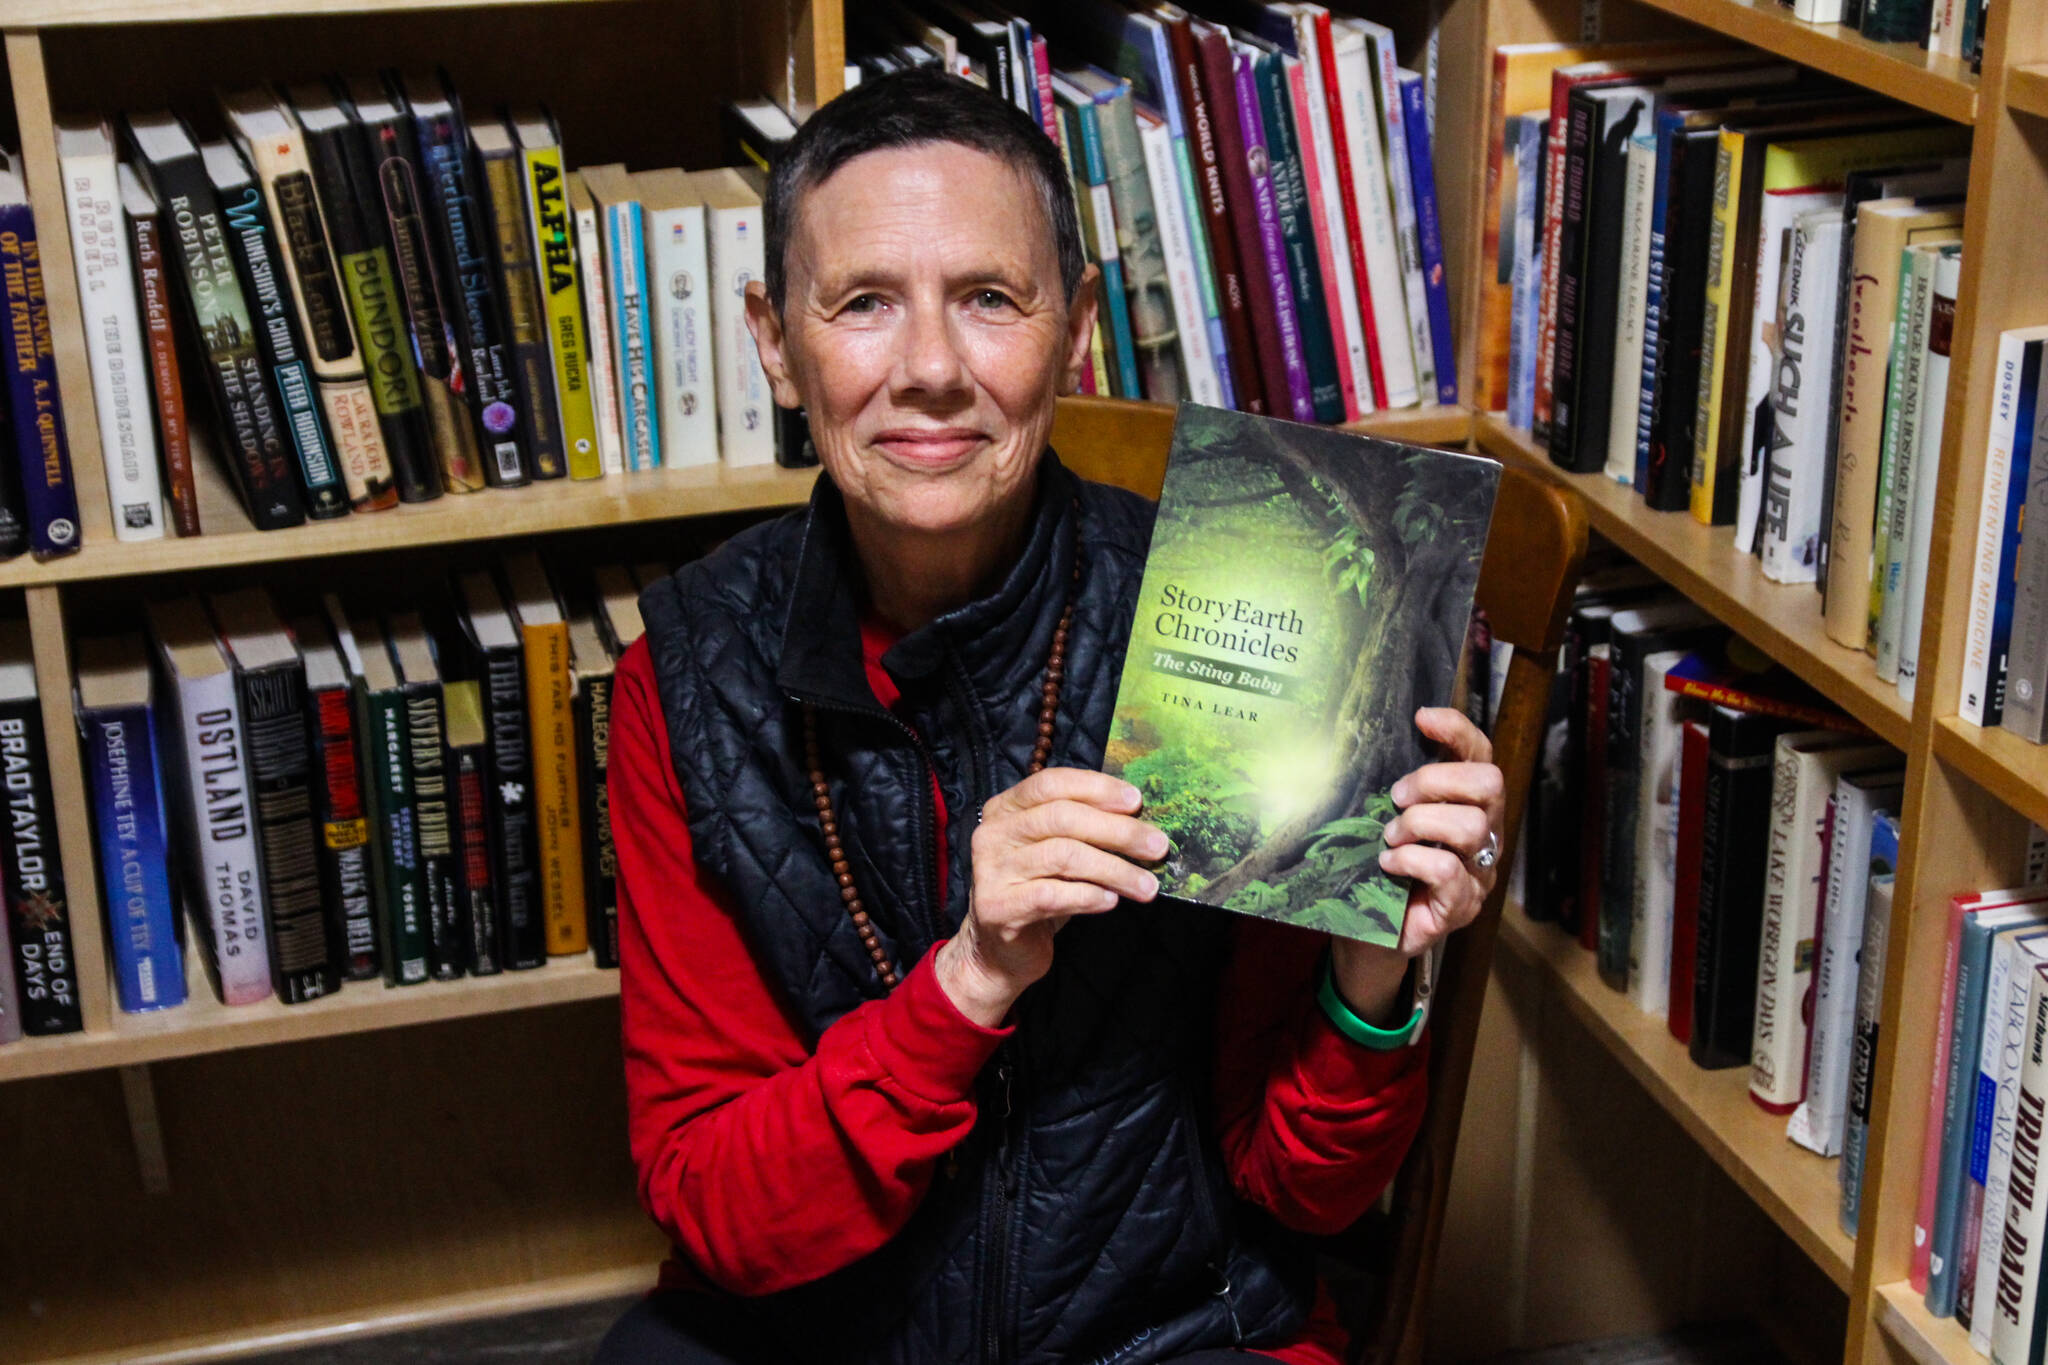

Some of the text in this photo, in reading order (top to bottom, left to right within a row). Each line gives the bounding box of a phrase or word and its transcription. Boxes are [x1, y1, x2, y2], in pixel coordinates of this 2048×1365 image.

[1195, 102, 1216, 162] WORLD
[440, 163, 485, 270] Perfumed
[1205, 163, 1226, 215] KNITS
[1271, 160, 1299, 237] ANTIQUES
[1567, 157, 1586, 224] COWARD
[74, 177, 107, 292] RENDELL
[96, 200, 119, 268] RUTH
[170, 195, 217, 313] ROBINSON
[200, 213, 234, 287] PETER
[533, 161, 574, 296] ALPHA
[1626, 162, 1648, 344] THE MAZARINE LEGACY
[0, 231, 37, 372] OF THE FATHER
[22, 240, 53, 358] IN THE NAME
[135, 219, 166, 332] Ruth Rendell
[461, 274, 491, 344] Sleeve
[354, 258, 405, 409] BUNDORI
[488, 344, 503, 381] Laura
[558, 315, 582, 393] GREG RUCKA
[1642, 302, 1662, 384] STREET
[1845, 274, 1878, 424] Sweethearts
[102, 314, 140, 482] THE BRIDESMAID
[156, 352, 173, 398] DEMON
[471, 347, 497, 403] Rowland
[624, 292, 652, 458] HAVE HIS CARCASE
[1892, 275, 1927, 541] HOSTAGE BOUND, HOSTAGE FREE
[35, 413, 62, 488] QUINNELL
[217, 358, 267, 489] THE SHADOWS
[240, 357, 287, 479] STANDING IN
[280, 365, 331, 483] PETER ROBINSON
[333, 394, 364, 477] ROWLAND
[351, 391, 381, 473] LAURA JOH
[1765, 313, 1805, 543] SUCH A LIFE
[1970, 360, 2014, 673] DOSSEY REINVENTING MEDICINE
[1160, 583, 1304, 635] StoryEarth
[1888, 561, 1901, 593] Weir
[548, 633, 560, 672] THIS
[1152, 652, 1284, 697] The Sting Baby
[1155, 612, 1299, 664] Chronicles
[407, 698, 442, 770] SISTERS
[488, 658, 527, 774] THE ECHO
[554, 720, 565, 747] NO
[591, 681, 609, 769] HARLEQUIN
[1161, 692, 1260, 723] TINA LEAR
[100, 720, 132, 810] JOSEPHINE
[195, 707, 247, 842] OSTLAND
[383, 707, 404, 794] MARGARET
[0, 717, 46, 891] BRAD TAYLOR
[115, 813, 137, 841] TEY
[556, 751, 569, 828] FURTHER
[120, 847, 138, 861] A
[416, 800, 451, 857] CRIME
[123, 861, 143, 890] CUP
[127, 892, 147, 920] OF
[237, 870, 259, 940] DAVID
[338, 847, 366, 895] WALK
[401, 882, 418, 934] YORKE
[131, 921, 152, 951] TEY
[215, 862, 242, 957] THOMAS
[345, 918, 376, 957] HELL
[1760, 833, 1788, 1046] LAKE WOBEGON DAYS
[22, 943, 46, 1001] DAYS
[44, 931, 71, 1006] END OF
[1953, 964, 1969, 1035] LITERATURE
[2032, 991, 2048, 1064] Starhawk
[1855, 1039, 1874, 1114] GENE
[1944, 1062, 1957, 1118] MEDICINE
[1993, 980, 2028, 1159] TABOO SCARF
[1996, 1084, 2046, 1327] TRUTH or DARE
